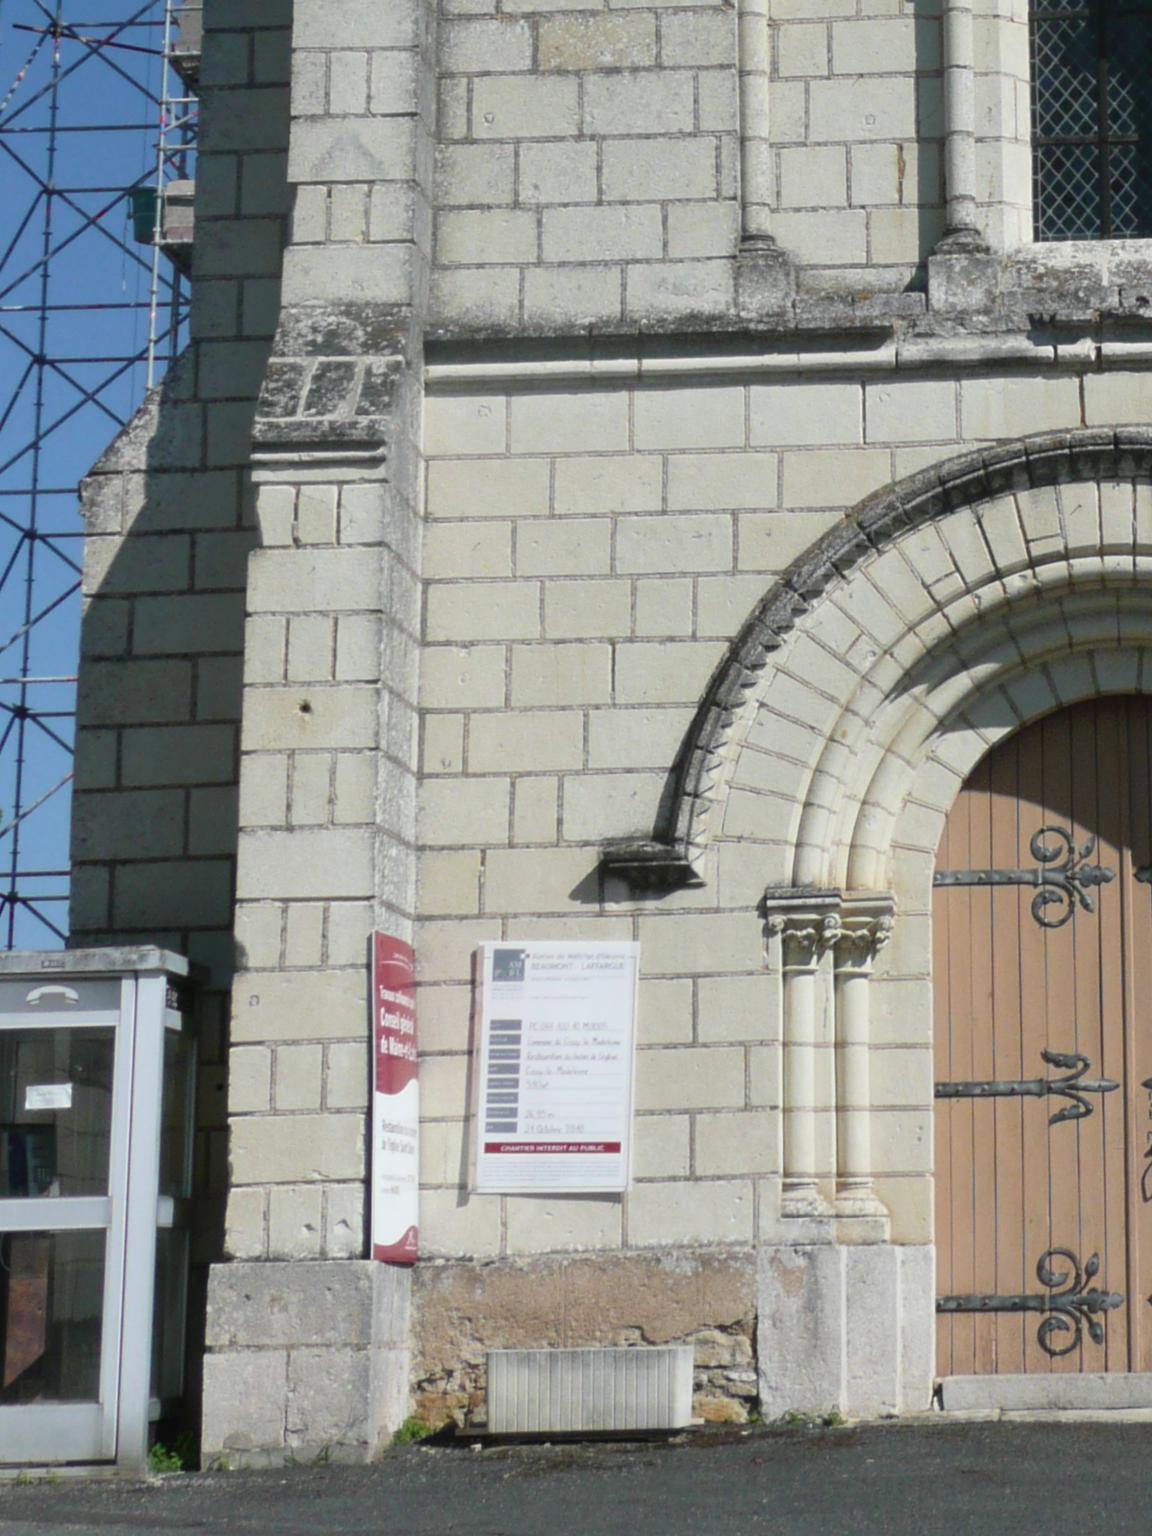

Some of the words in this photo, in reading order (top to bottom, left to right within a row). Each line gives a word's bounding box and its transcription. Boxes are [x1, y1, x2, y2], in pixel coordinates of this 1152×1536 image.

[380, 1007, 400, 1031] Conseil
[380, 1034, 388, 1054] de
[500, 1144, 535, 1152] CHANTIER
[536, 1144, 567, 1152] INTERDIT
[568, 1144, 579, 1152] AU
[579, 1144, 605, 1152] PUBLIC
